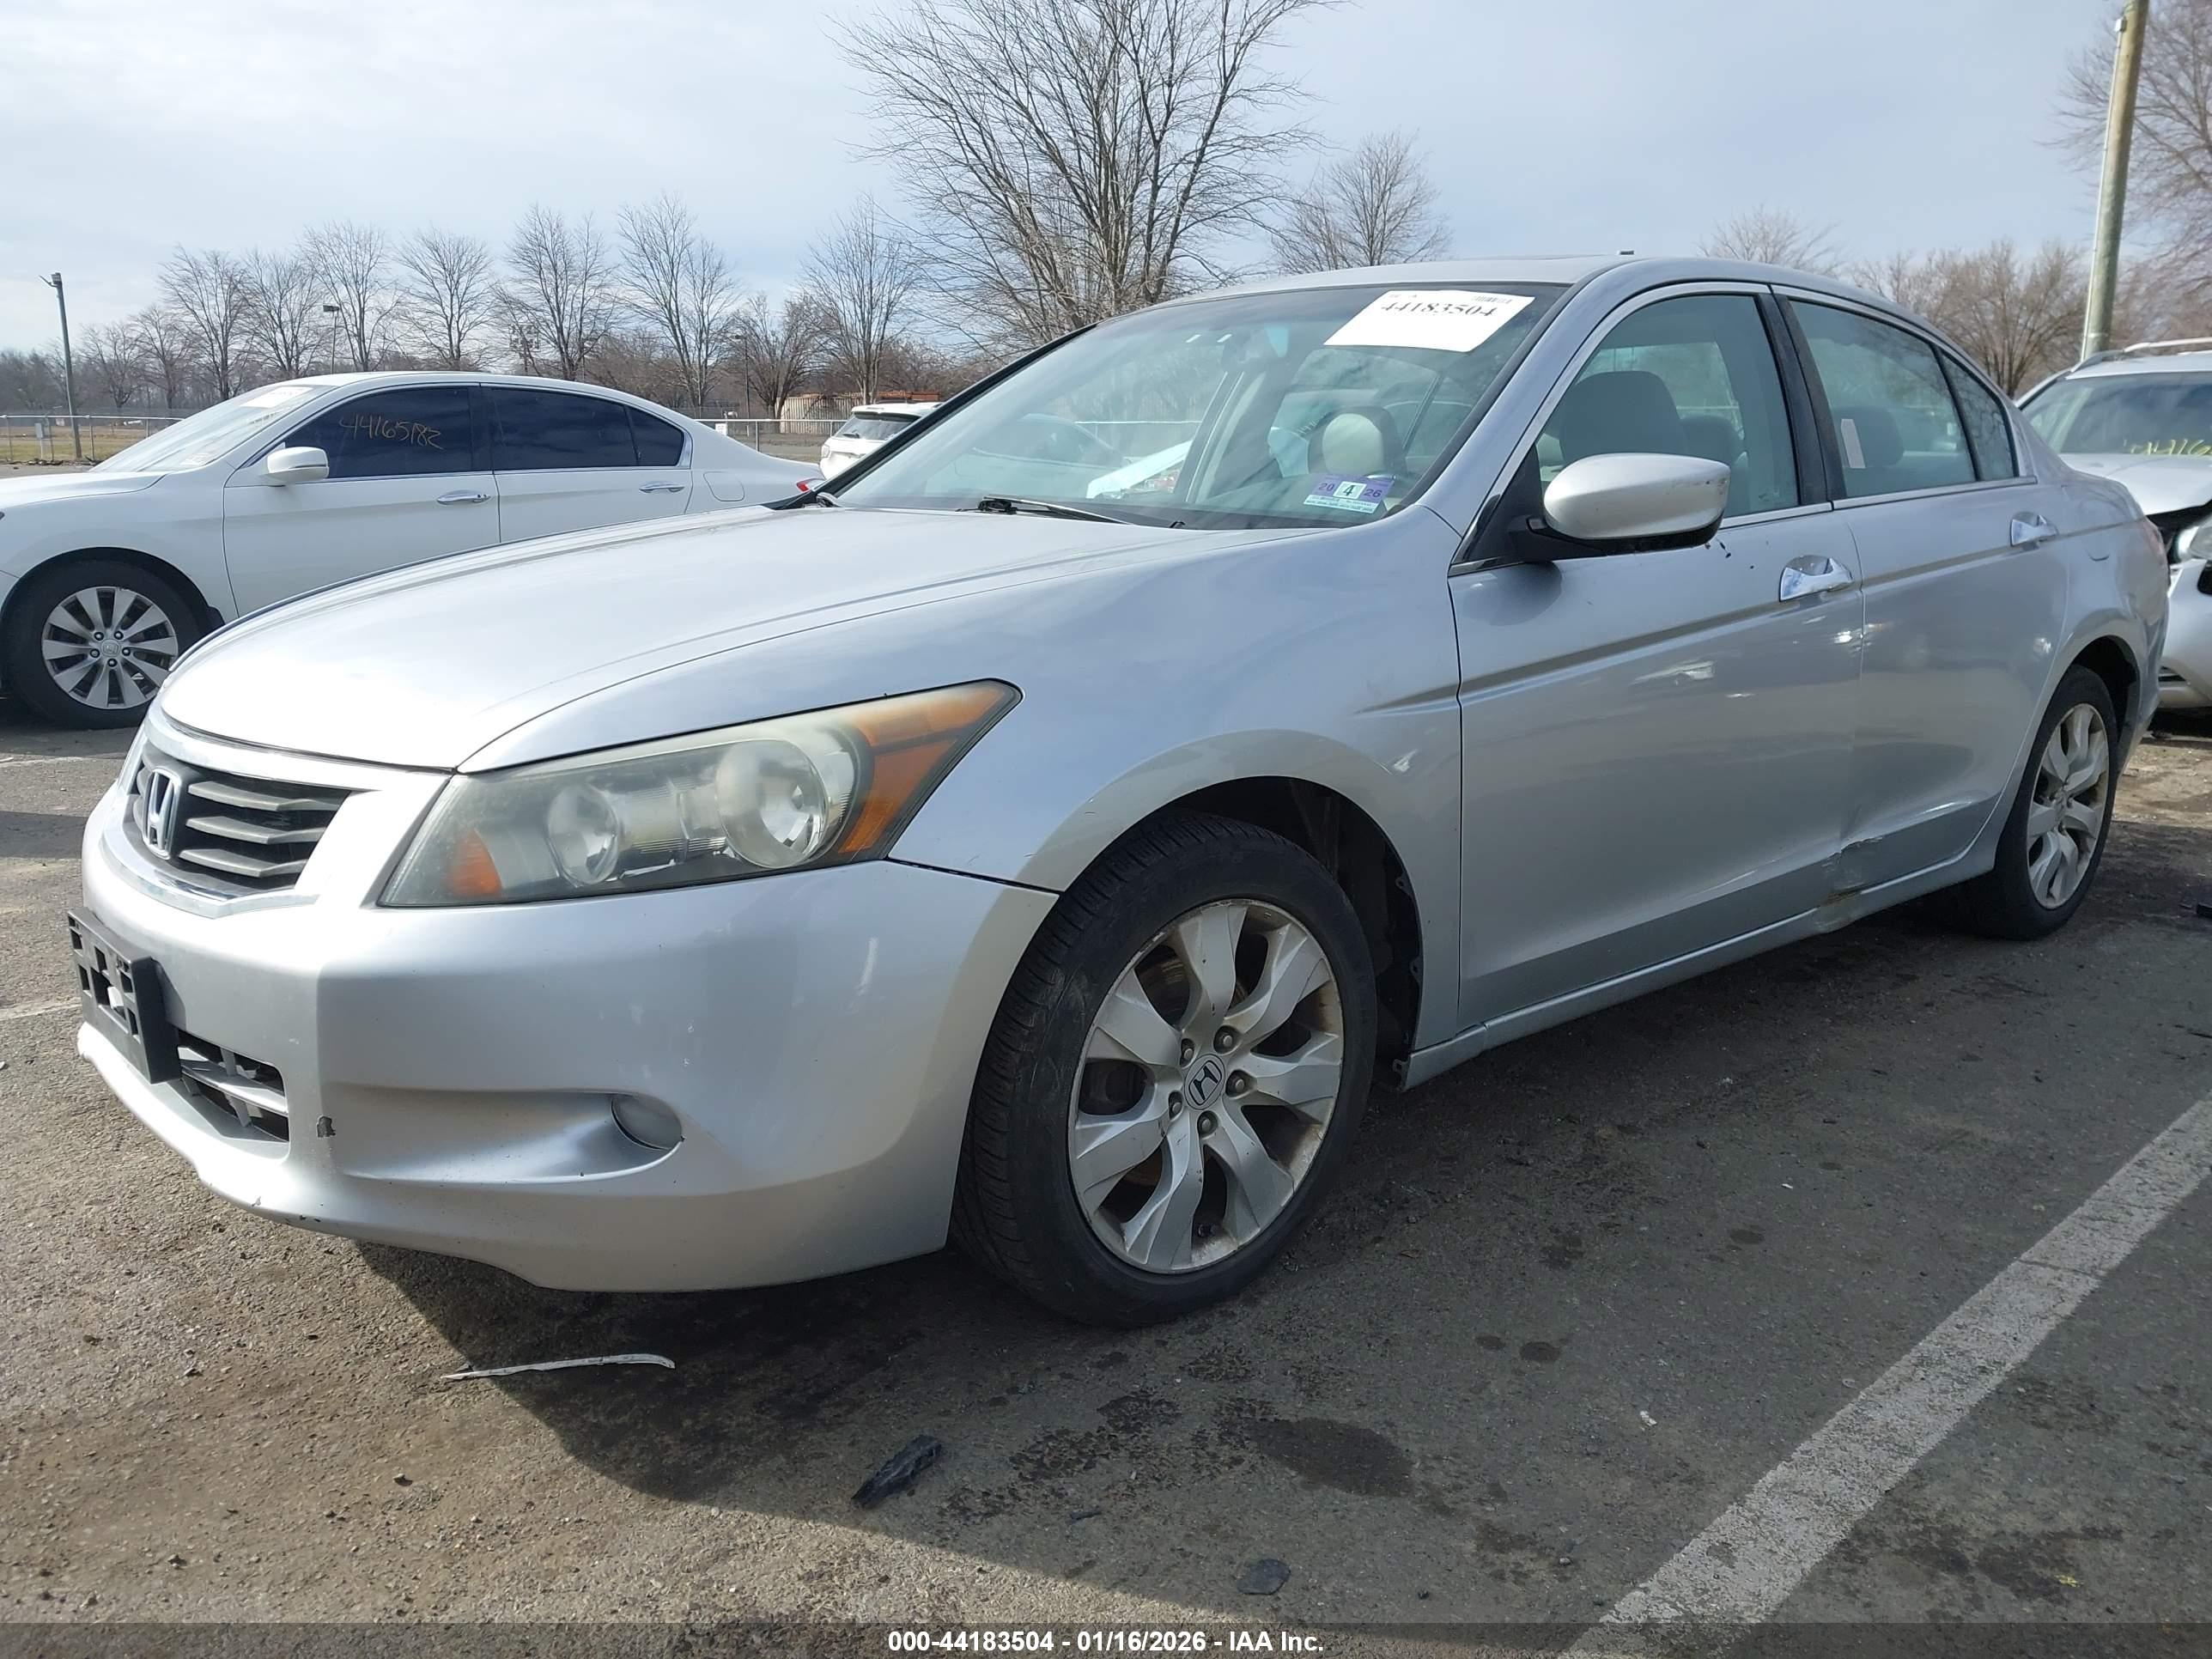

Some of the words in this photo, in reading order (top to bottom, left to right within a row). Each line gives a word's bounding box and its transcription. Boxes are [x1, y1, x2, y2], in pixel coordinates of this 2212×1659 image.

[1381, 301, 1498, 317] 44183504
[338, 413, 445, 451] 44165182
[1318, 482, 1335, 492] 20
[1343, 484, 1356, 496] 4
[1364, 489, 1382, 498] 26
